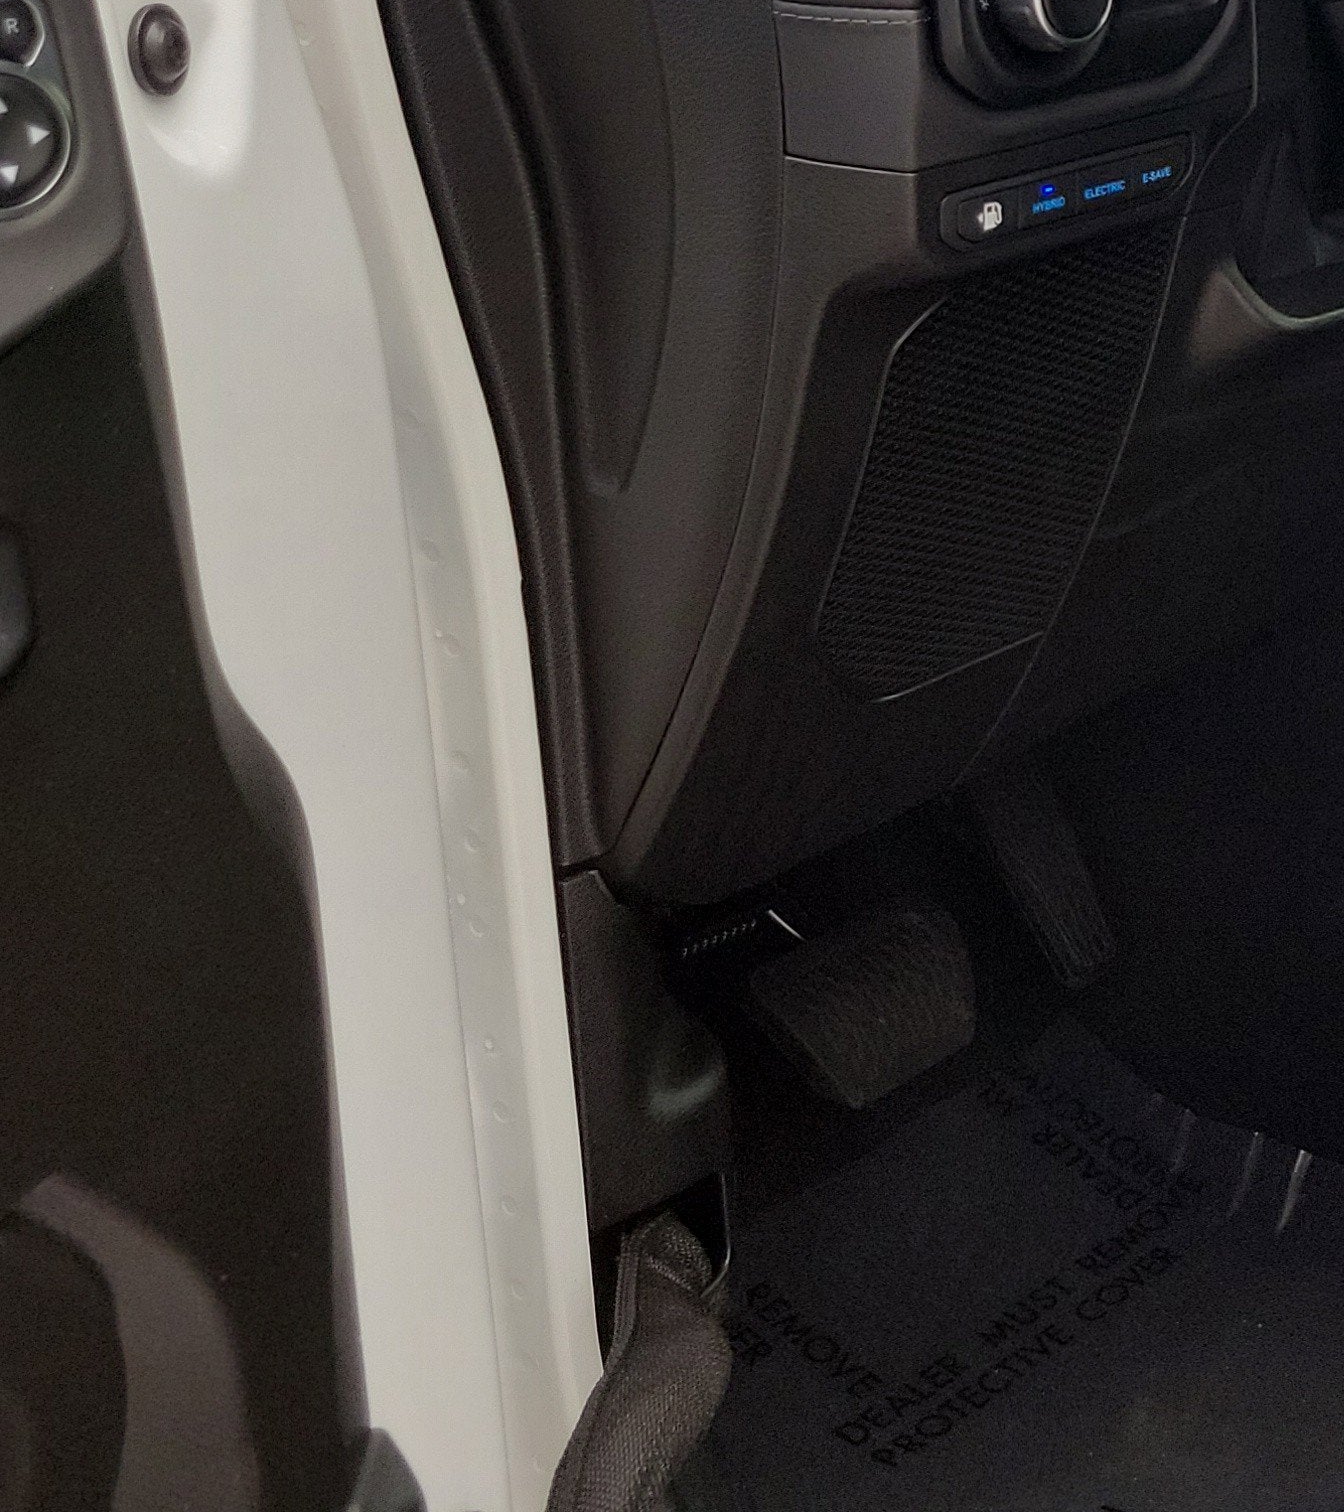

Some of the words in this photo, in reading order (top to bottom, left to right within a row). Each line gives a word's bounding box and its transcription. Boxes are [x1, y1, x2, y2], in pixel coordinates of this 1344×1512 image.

[6, 18, 19, 35] R
[1141, 165, 1173, 185] E-SAVE
[1083, 180, 1126, 201] ELECTRIC
[1031, 196, 1066, 215] HYBRID
[833, 1352, 971, 1448] DEALER
[980, 1276, 1075, 1349] MUST
[1075, 1174, 1206, 1276] REMOVE
[745, 1281, 884, 1399] REMOVE
[871, 1325, 1075, 1469] PROTECTIVE
[1075, 1245, 1184, 1324] COVER
